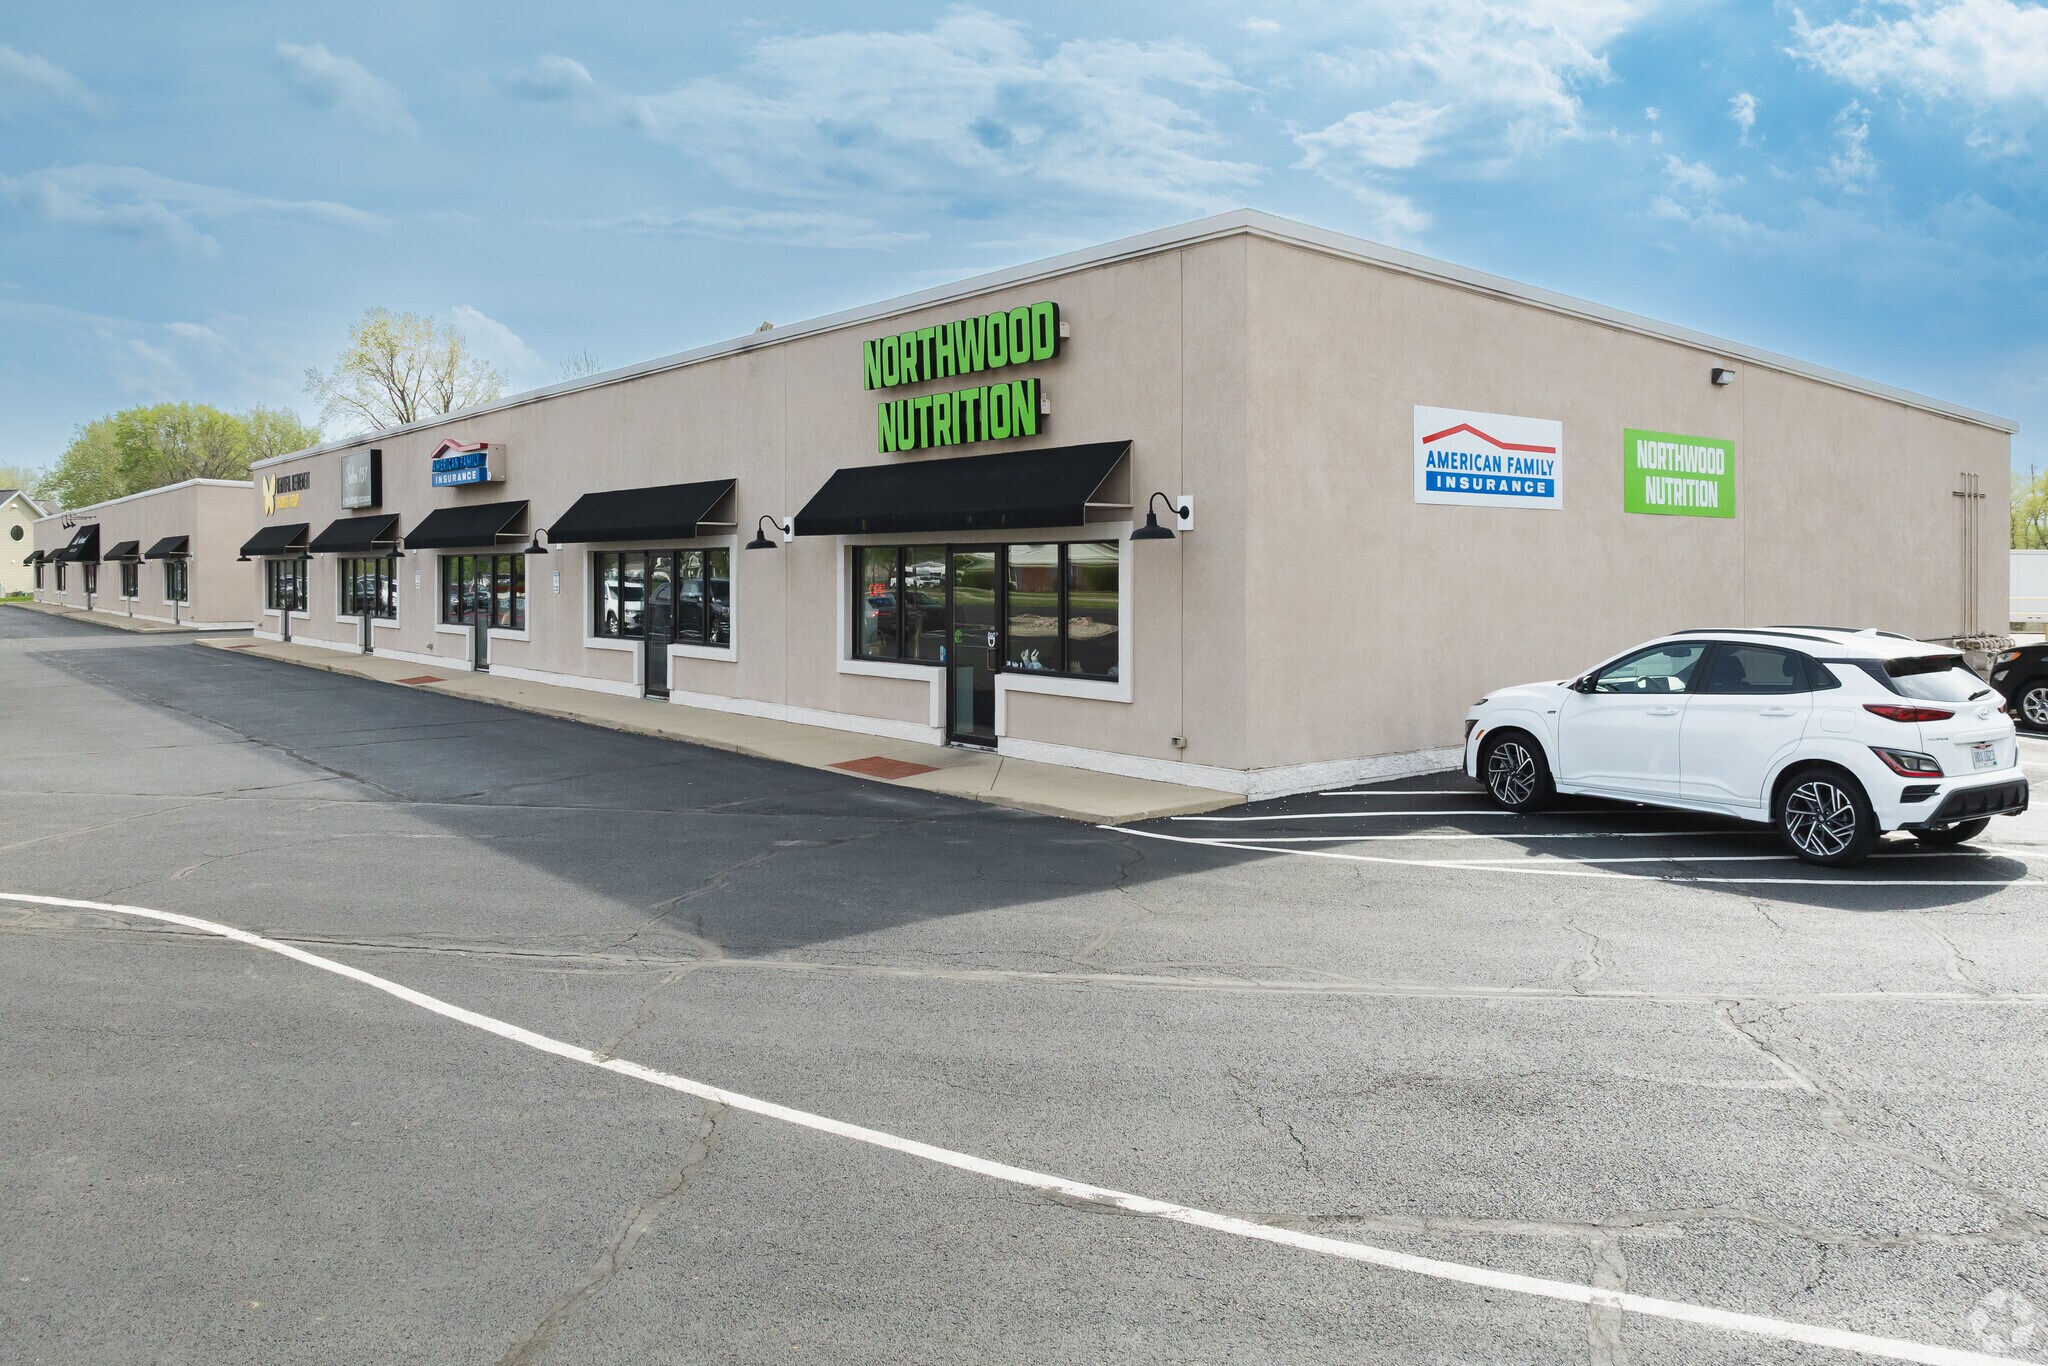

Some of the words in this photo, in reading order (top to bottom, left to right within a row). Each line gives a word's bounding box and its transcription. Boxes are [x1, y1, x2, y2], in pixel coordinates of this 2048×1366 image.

[863, 301, 1060, 391] NORTHWOOD
[878, 378, 1042, 453] NUTRITION
[1426, 450, 1501, 473] AMERICAN
[1507, 457, 1554, 476] FAMILY
[1637, 440, 1725, 475] NORTHWOOD
[435, 470, 477, 484] INSURANCE
[1436, 475, 1546, 493] INSURANCE
[1645, 476, 1718, 508] NUTRITION
